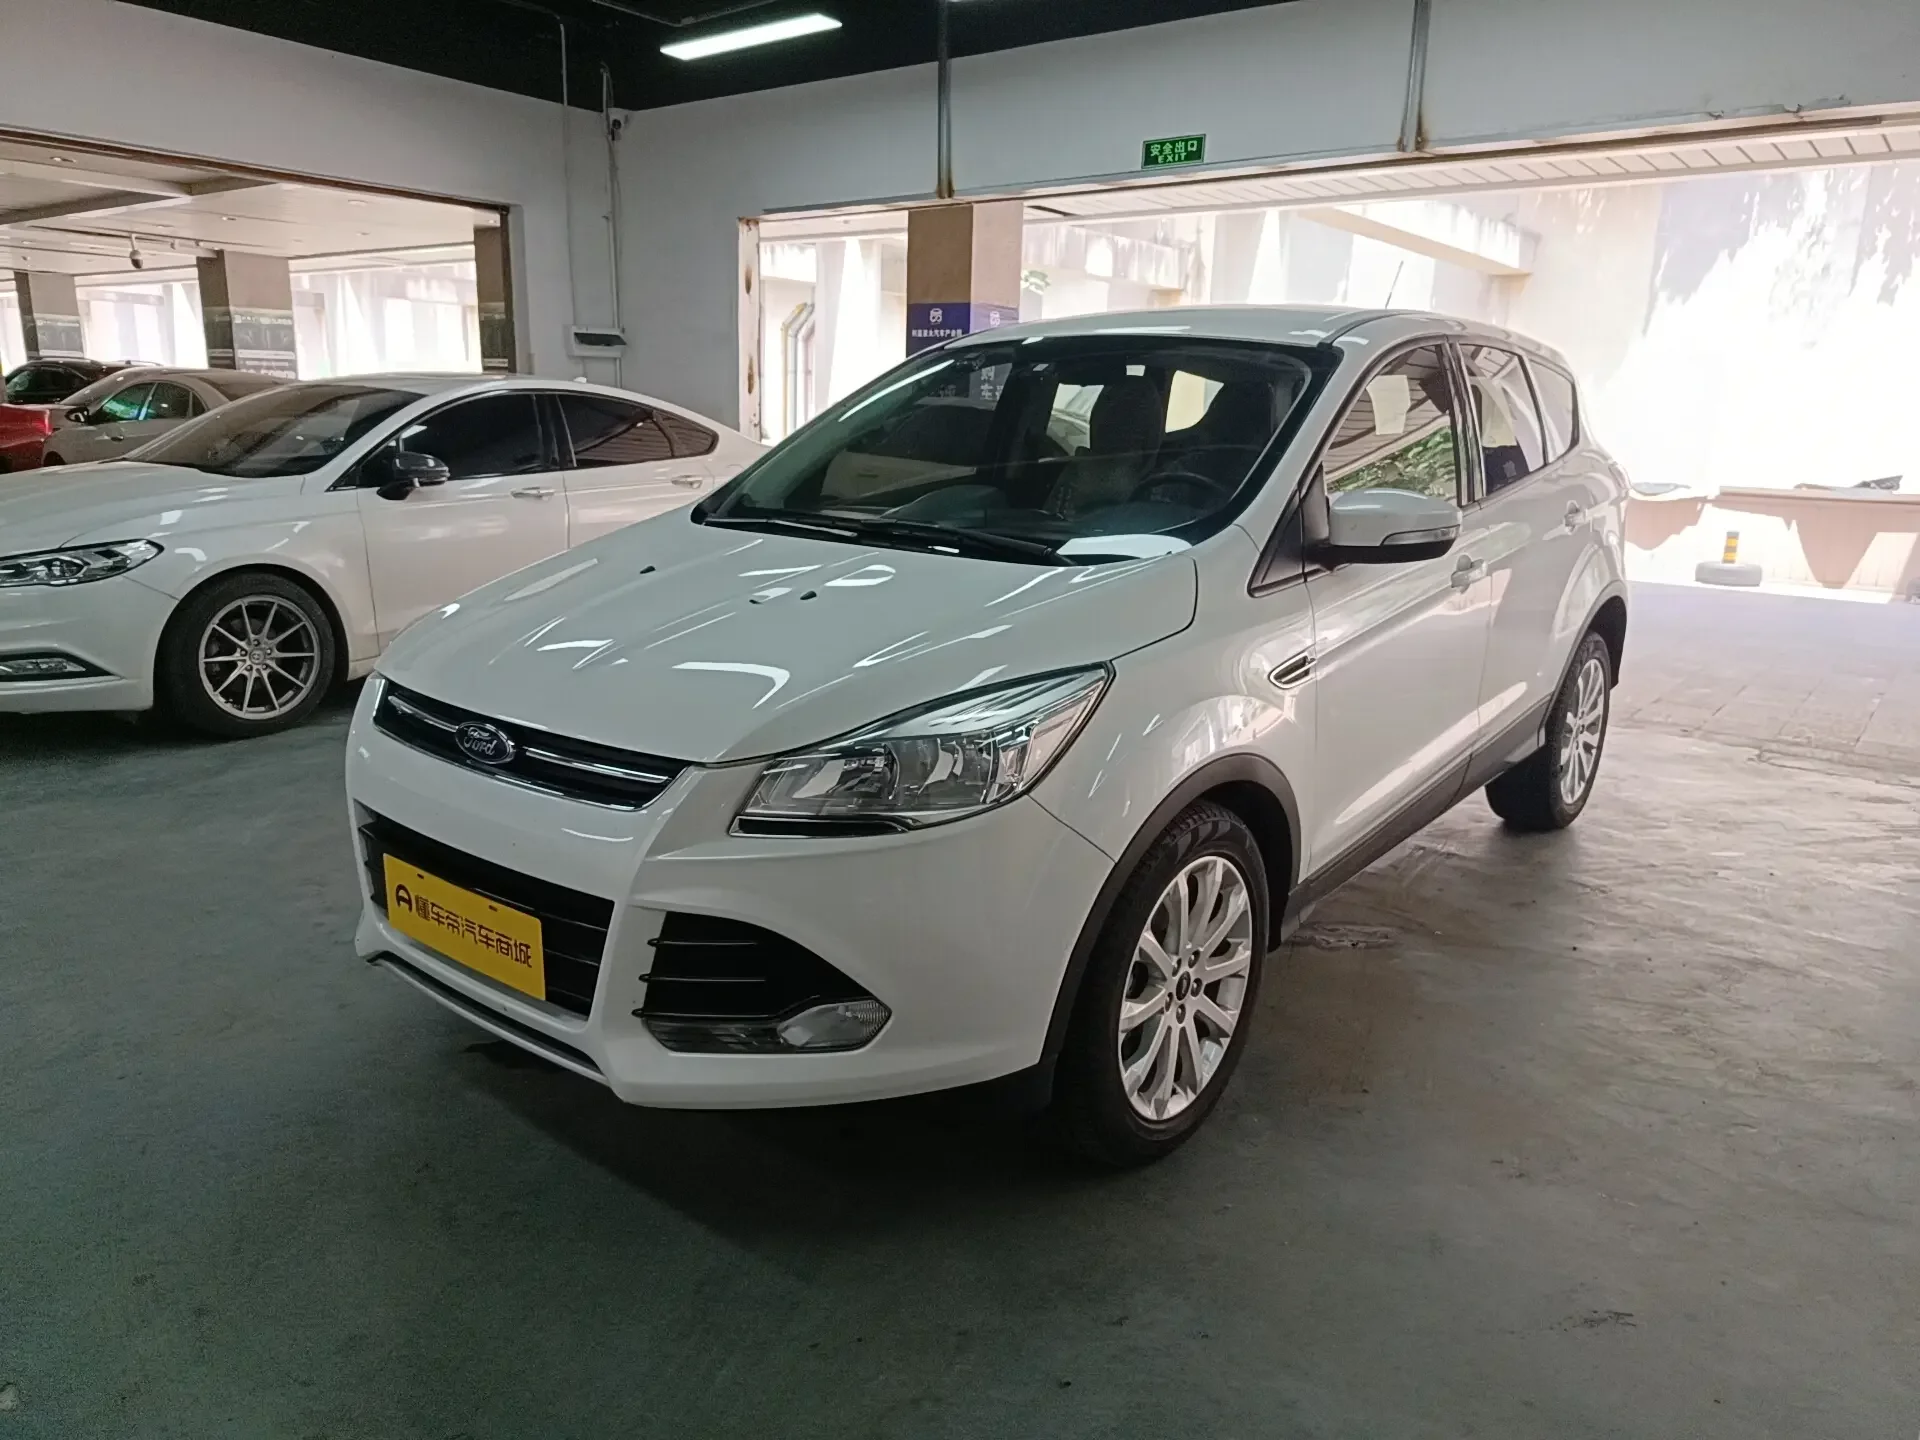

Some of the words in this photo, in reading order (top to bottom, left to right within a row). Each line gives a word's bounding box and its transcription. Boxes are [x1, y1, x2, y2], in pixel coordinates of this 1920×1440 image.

[1150, 140, 1197, 156] 安全出口
[1157, 152, 1188, 164] EXIT
[463, 726, 498, 756] Ford
[414, 894, 533, 969] 懂车帝汽车商城
